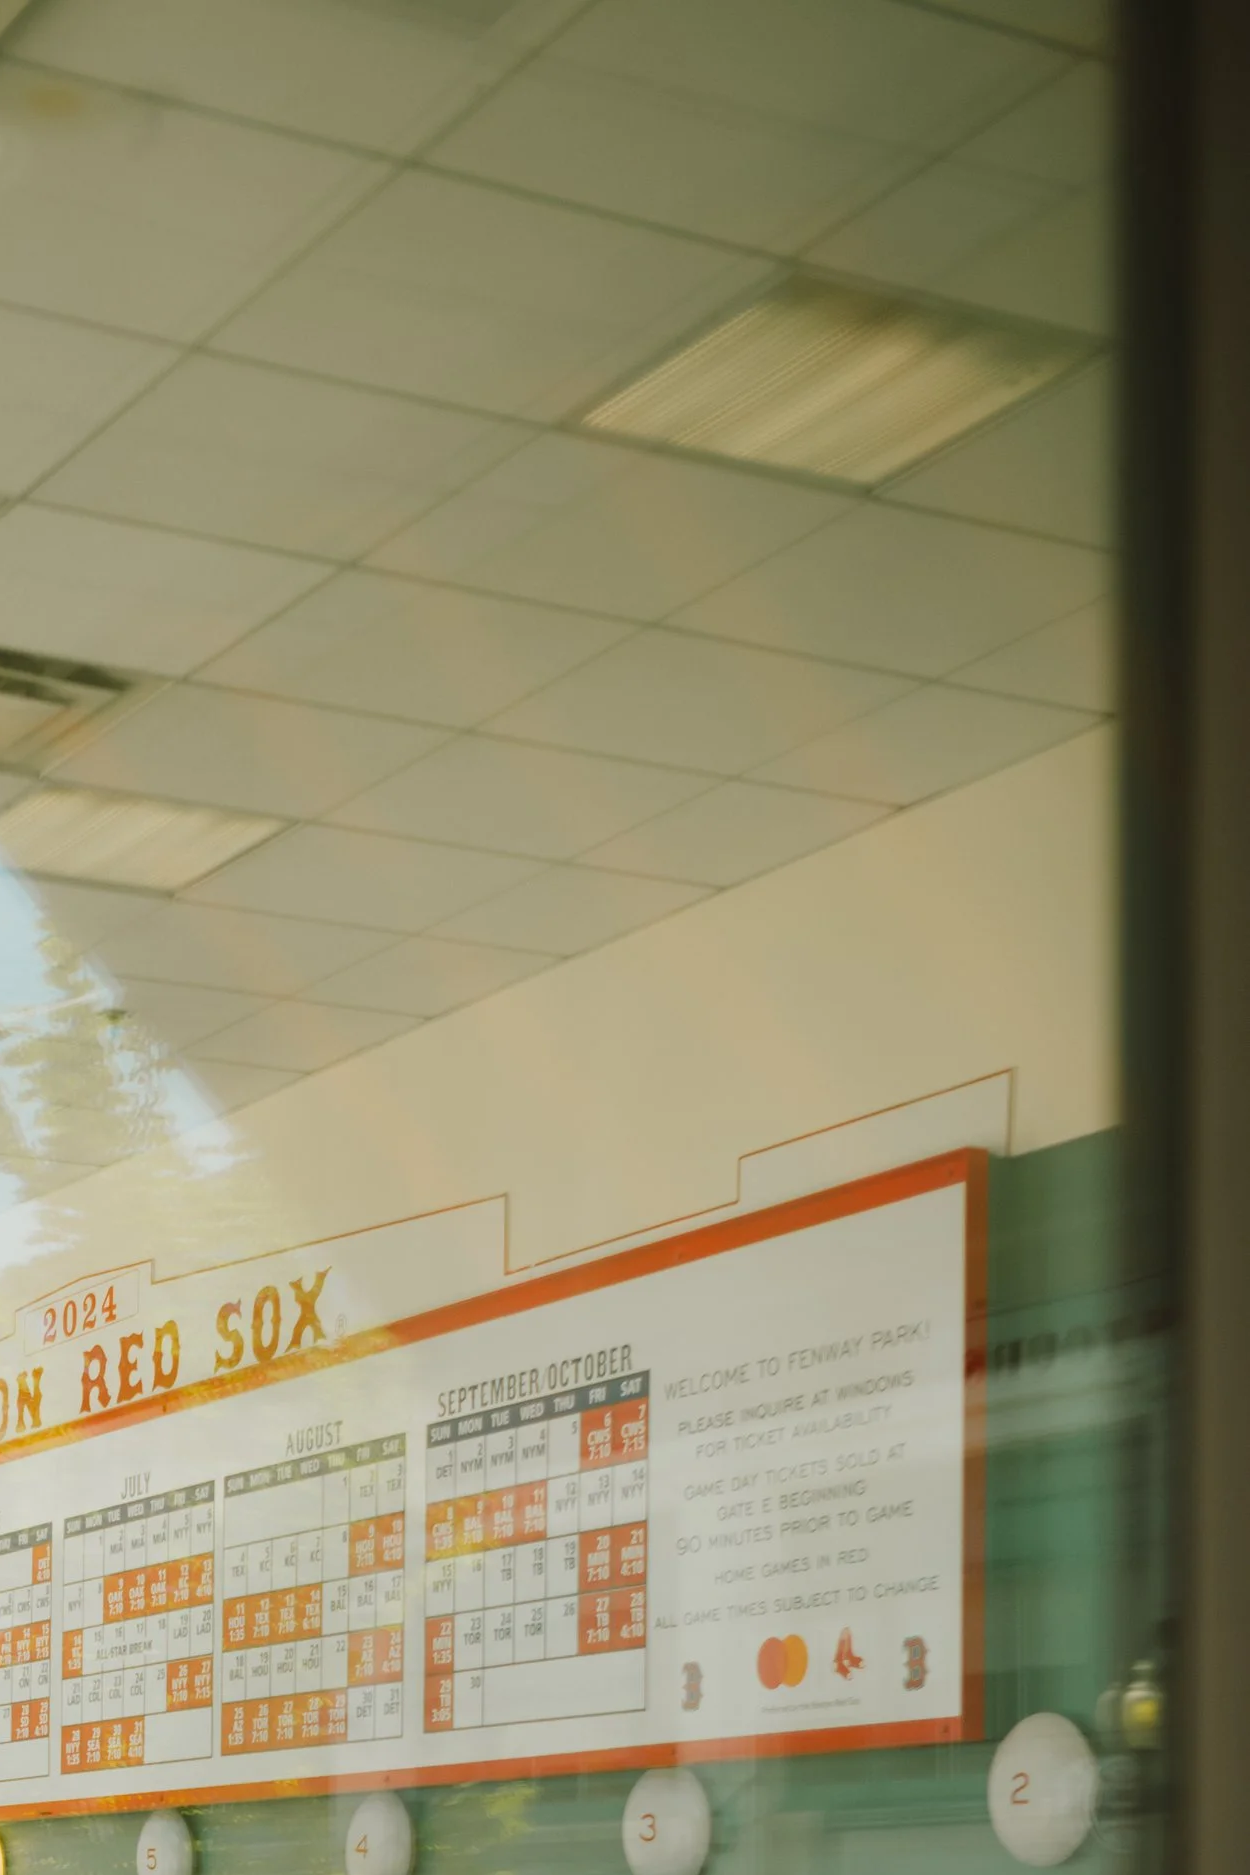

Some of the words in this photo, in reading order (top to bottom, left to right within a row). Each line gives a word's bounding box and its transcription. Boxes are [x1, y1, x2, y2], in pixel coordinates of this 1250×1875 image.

[42, 1284, 117, 1346] 2024
[79, 1319, 181, 1414] RED
[214, 1265, 333, 1374] SOX
[664, 1364, 750, 1400] WELCOME
[756, 1357, 781, 1377] TO
[787, 1336, 865, 1370] FENWAY
[430, 1426, 450, 1443] SUN
[458, 1416, 483, 1435] MON
[490, 1410, 510, 1427] TUE
[519, 1402, 544, 1421] WED
[554, 1394, 575, 1413] THU
[588, 1386, 607, 1404] FRI
[620, 1378, 641, 1397] SAT
[638, 1404, 646, 1419] 7
[677, 1411, 734, 1436] PLEASE
[741, 1395, 804, 1423] INQUIRE
[810, 1390, 830, 1407] AT
[834, 1370, 915, 1401] WINDOWS
[286, 1420, 343, 1456] AUGUST
[695, 1441, 726, 1460] FOR
[733, 1427, 786, 1453] TICKET
[121, 1472, 151, 1500] JULY
[227, 1477, 244, 1493] SUN
[277, 1466, 292, 1481] TUE
[301, 1459, 320, 1475] WED
[683, 1479, 725, 1501] GAME
[731, 1471, 760, 1493] DAY
[765, 1458, 829, 1485] TICKETS
[835, 1448, 880, 1473] SOLD
[885, 1442, 907, 1461] AT
[66, 1519, 81, 1534] SUN
[107, 1509, 121, 1523] TUE
[676, 1535, 702, 1556] 90
[707, 1525, 773, 1550] MINUTES
[780, 1516, 831, 1538] PRIOR
[838, 1509, 859, 1528] TO
[864, 1500, 914, 1524] GAME
[716, 1500, 755, 1522] GATE
[714, 1567, 754, 1586] HOME
[761, 1558, 811, 1579] GAMES
[836, 1547, 869, 1566] RED
[654, 1615, 677, 1631] ALL
[683, 1608, 721, 1627] GAME
[726, 1599, 768, 1620] TIMES
[773, 1589, 841, 1614] SUBJECT
[847, 1585, 868, 1602] TO
[873, 1574, 941, 1599] CHANGE
[1010, 1771, 1030, 1805] 2
[639, 1813, 657, 1842] 3
[146, 1848, 157, 1871] 5
[354, 1834, 369, 1859] 4
